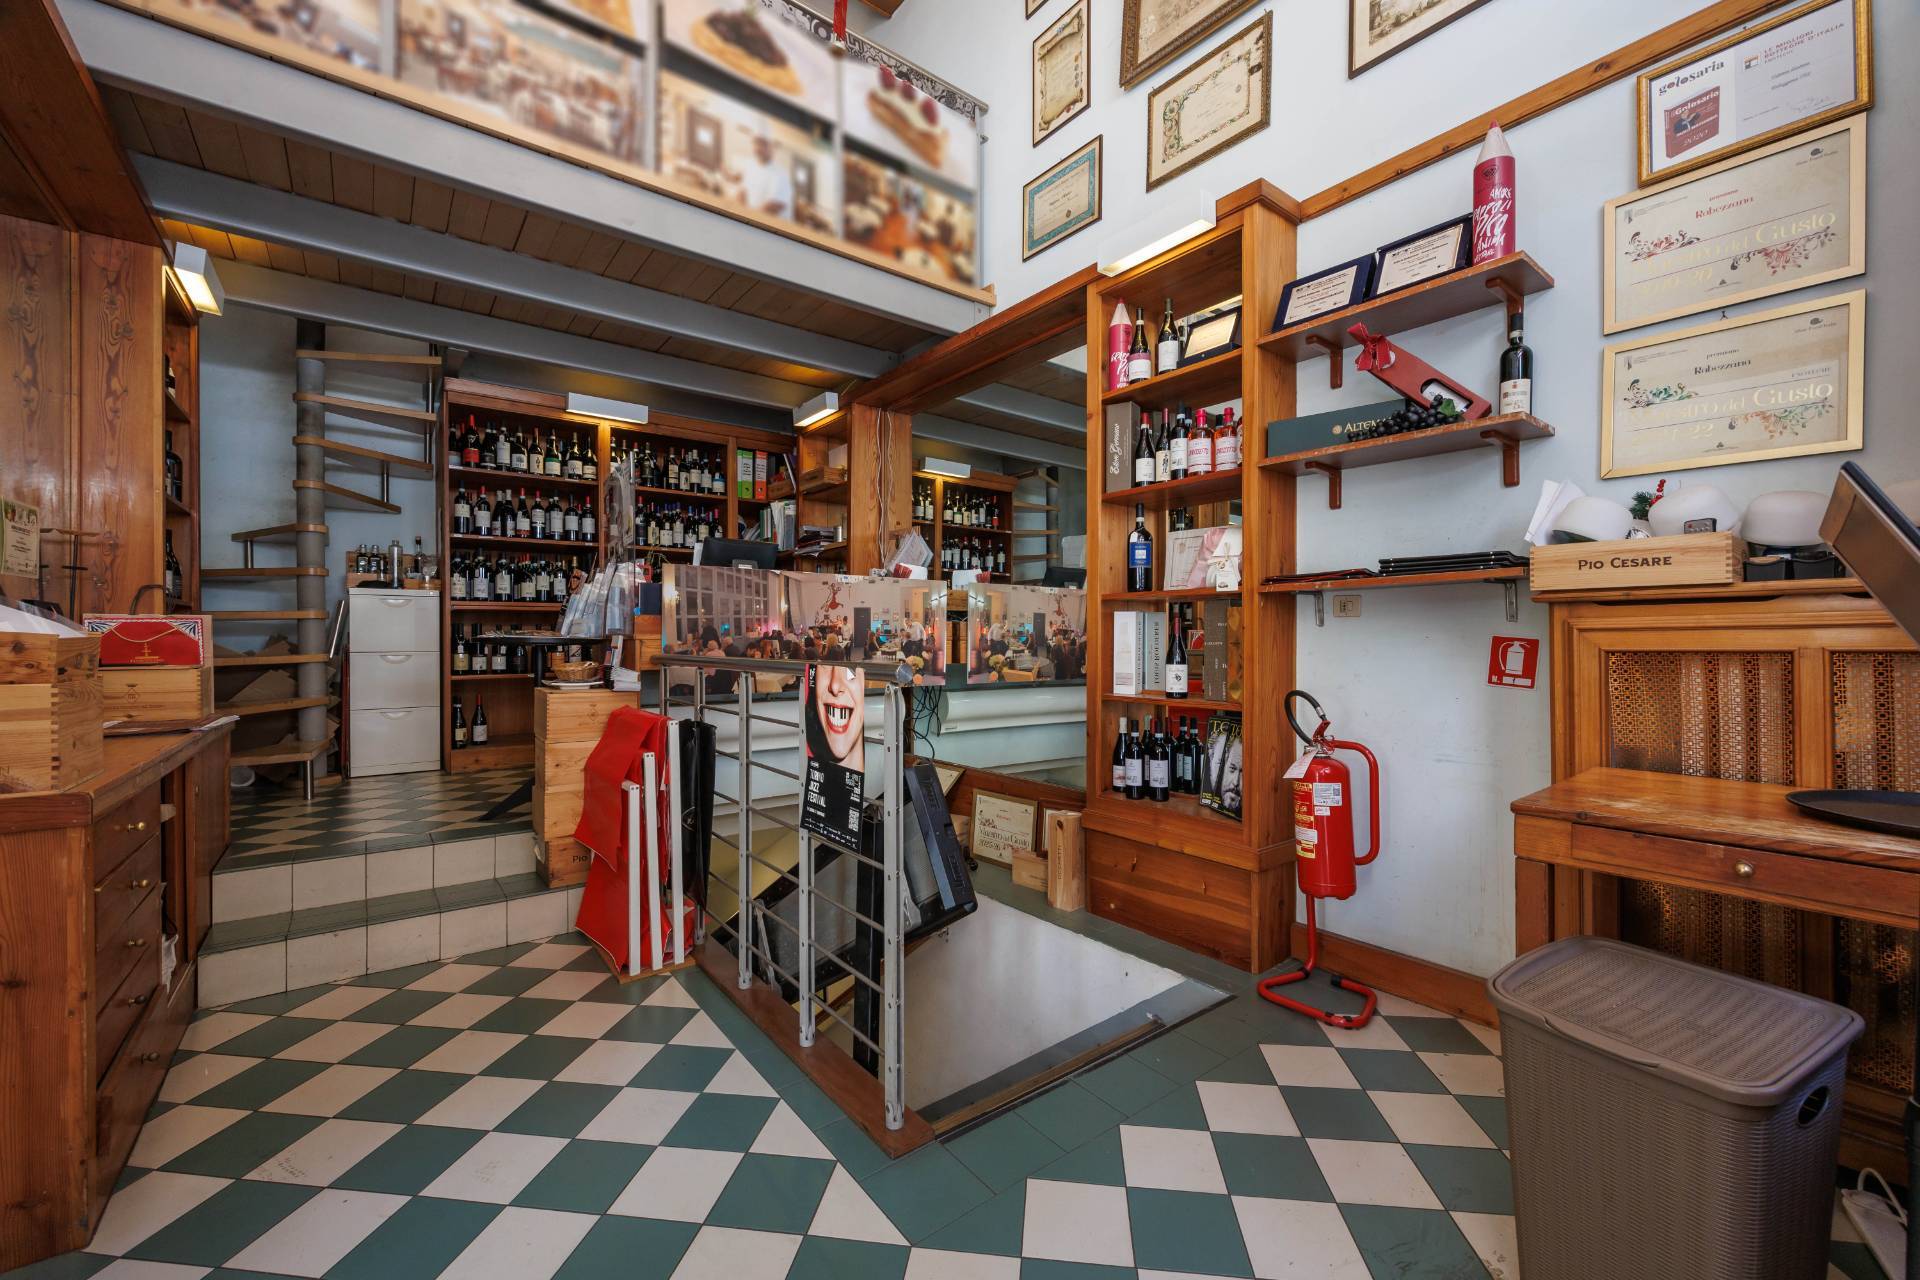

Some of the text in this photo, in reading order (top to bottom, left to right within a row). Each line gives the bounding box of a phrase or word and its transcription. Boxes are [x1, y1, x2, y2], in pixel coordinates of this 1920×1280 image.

[1658, 61, 1725, 96] golosaria
[1755, 211, 1837, 245] Gusto
[1694, 357, 1752, 376] Rabezzana
[1753, 382, 1834, 407] Gusto
